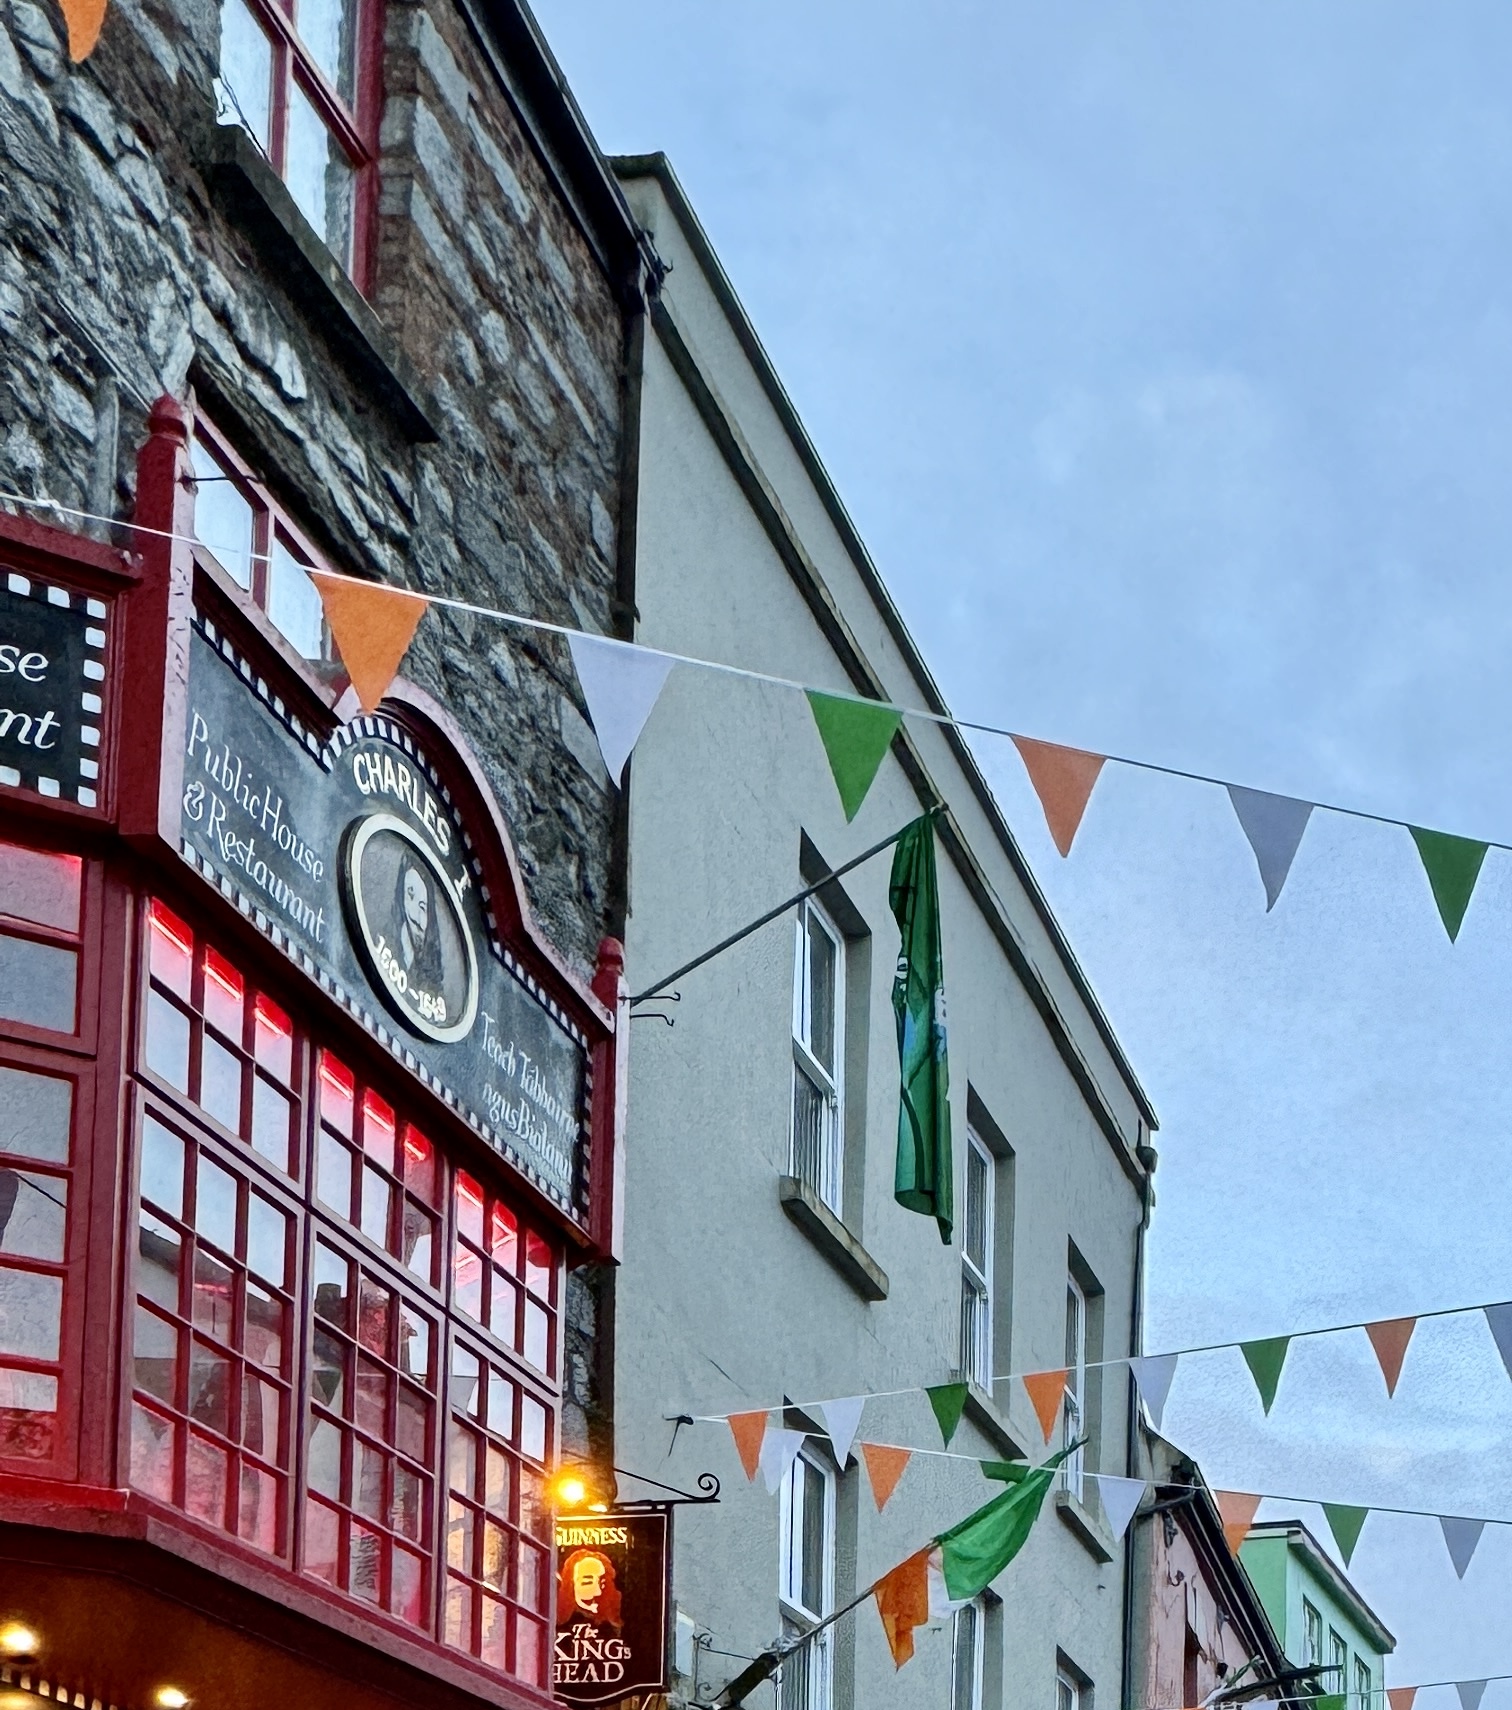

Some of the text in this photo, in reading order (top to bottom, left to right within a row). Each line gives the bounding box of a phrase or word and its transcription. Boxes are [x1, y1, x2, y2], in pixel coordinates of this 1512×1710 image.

[183, 780, 327, 943] & Restaurant
[187, 708, 324, 883] Public House
[353, 752, 451, 857] CHARLES
